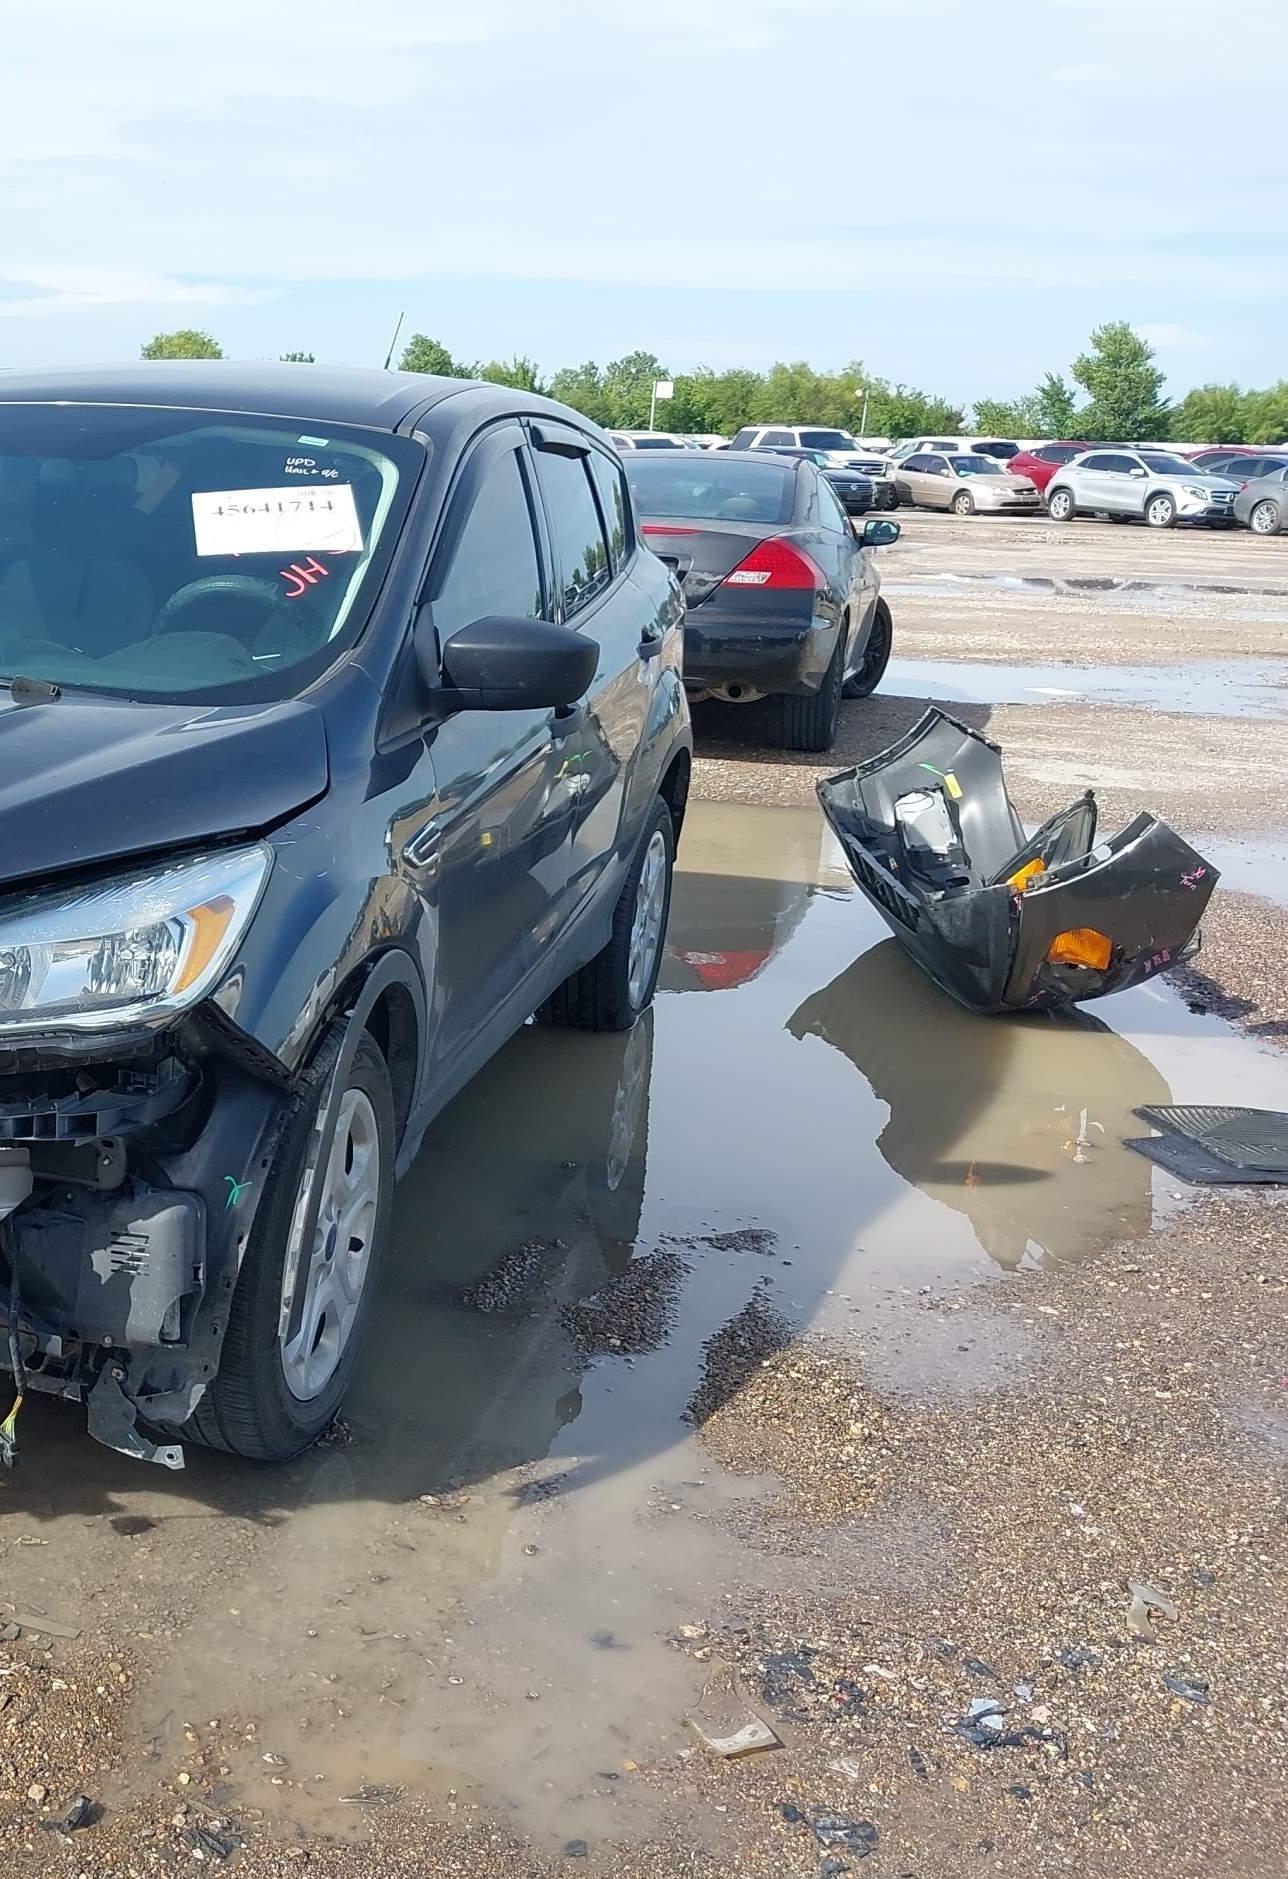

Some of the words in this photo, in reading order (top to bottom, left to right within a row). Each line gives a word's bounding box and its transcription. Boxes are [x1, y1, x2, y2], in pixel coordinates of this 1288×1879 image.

[286, 457, 316, 467] UPD
[211, 500, 334, 516] 45641714
[279, 556, 329, 597] JH
